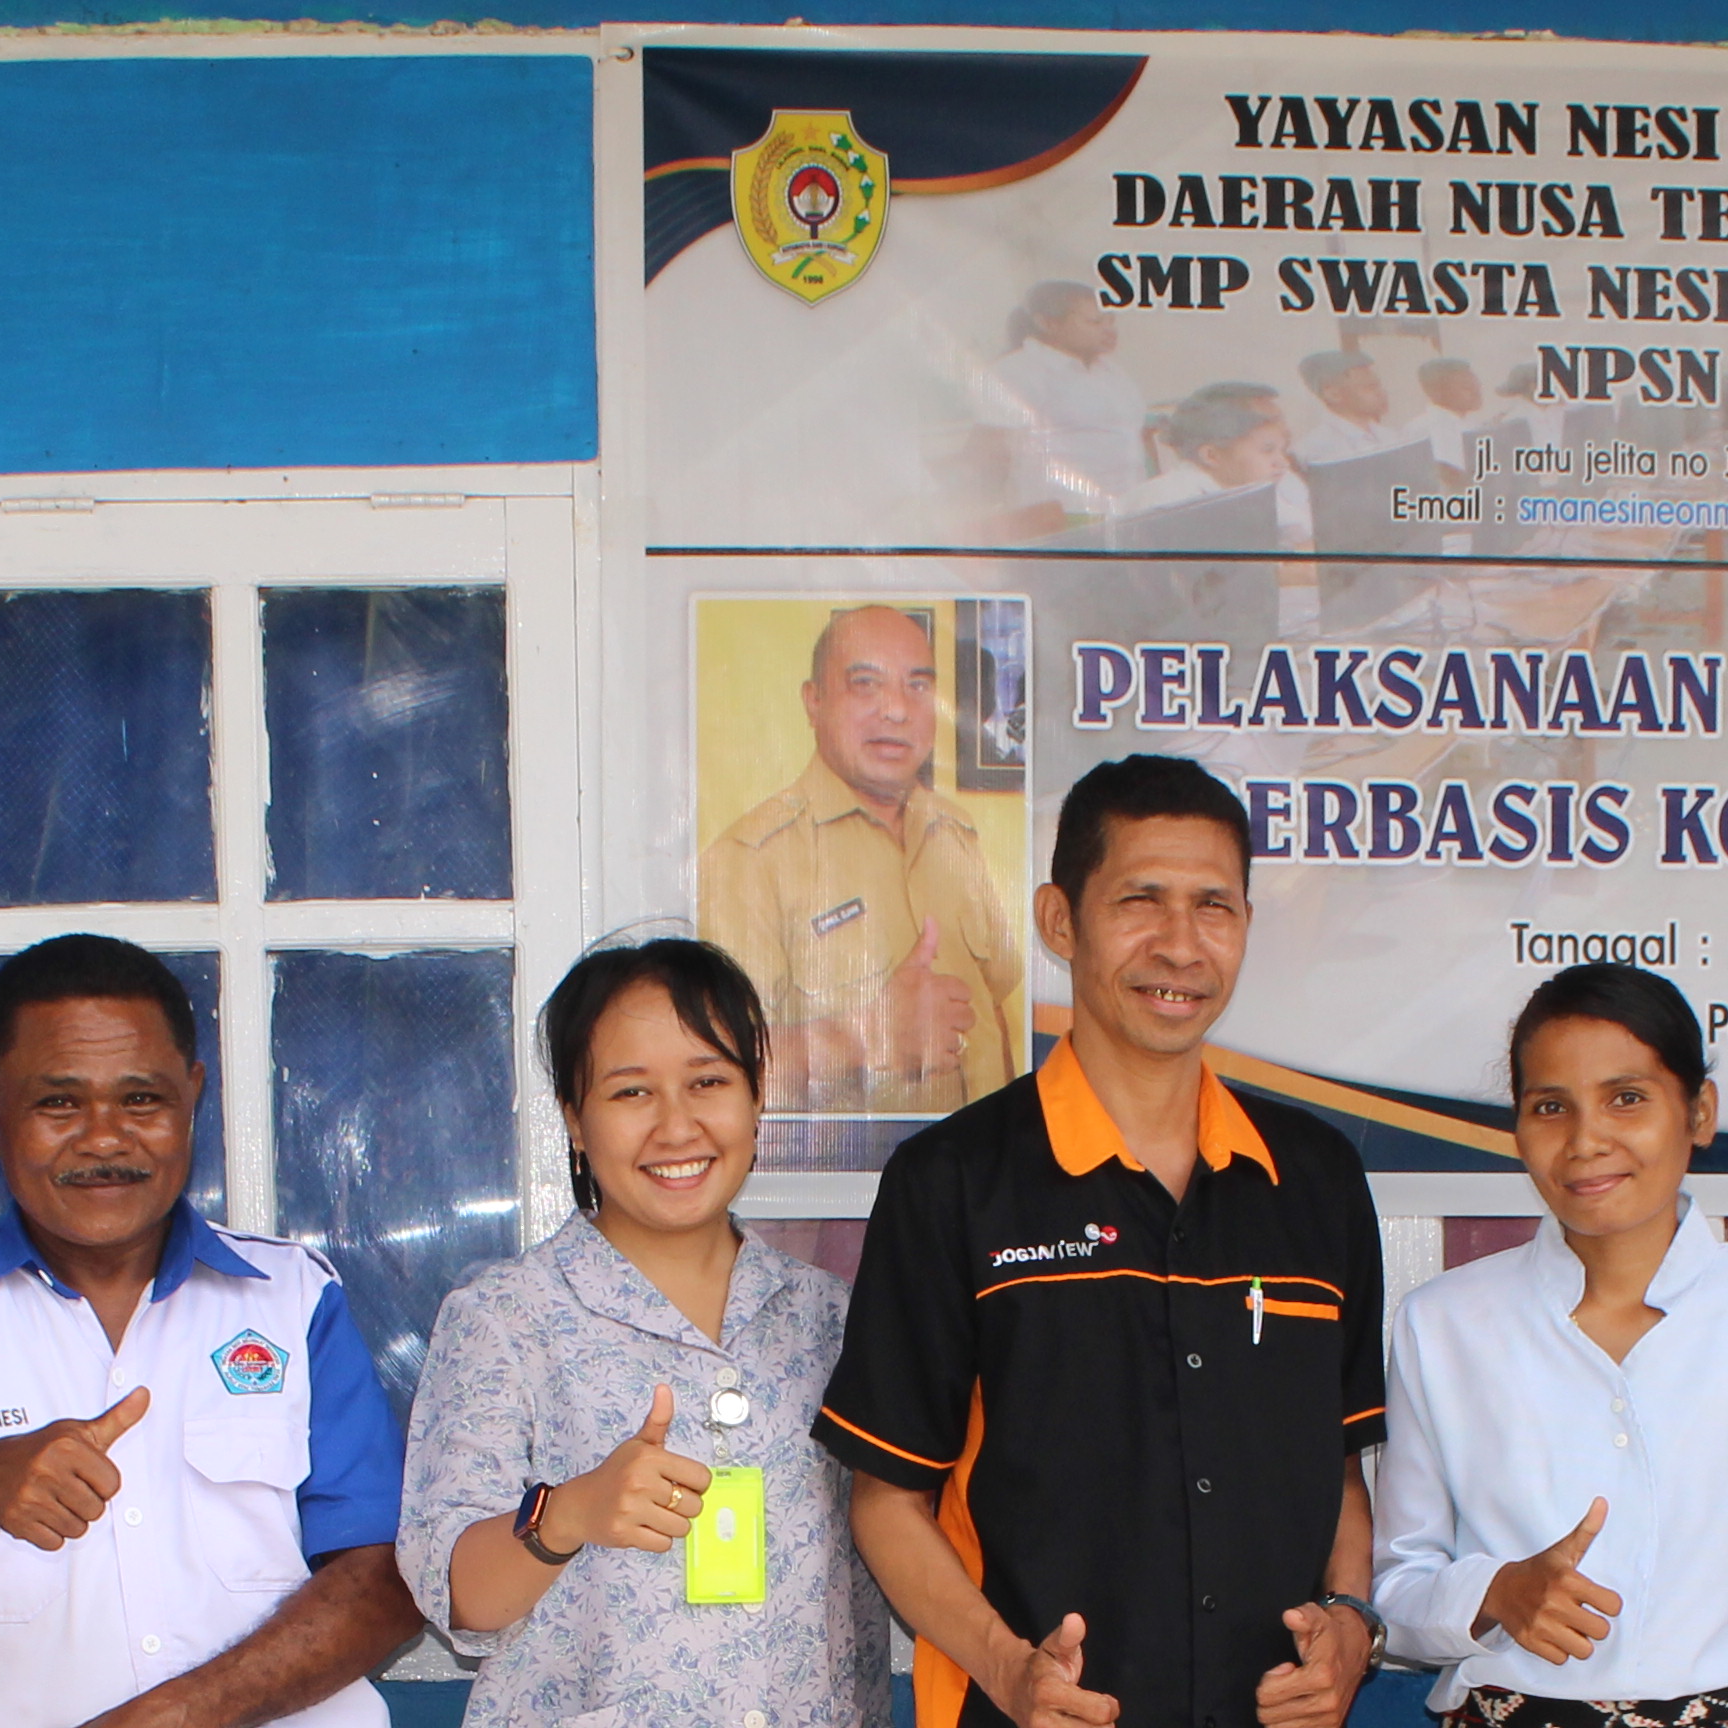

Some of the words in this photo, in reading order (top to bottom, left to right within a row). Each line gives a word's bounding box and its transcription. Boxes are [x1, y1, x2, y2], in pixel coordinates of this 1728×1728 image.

[1225, 95, 1538, 157] YAYASAN
[1567, 102, 1720, 162] NESI
[1113, 173, 1419, 234] DAERAH
[1449, 180, 1623, 240] NUSA
[1099, 255, 1249, 310] SMP
[1279, 259, 1557, 318] SWASTA
[1538, 346, 1719, 404] NPSN
[1475, 439, 1500, 480] jl.
[1515, 445, 1572, 476] ratu
[1586, 441, 1656, 482] jelita
[1670, 449, 1710, 479] no
[1392, 487, 1481, 524] E-mail
[1497, 497, 1503, 522] :
[1078, 647, 1722, 733] PELAKSANAAN
[1247, 782, 1629, 863] ERBASIS
[1511, 922, 1676, 965] Tanggal
[1702, 936, 1707, 965] :
